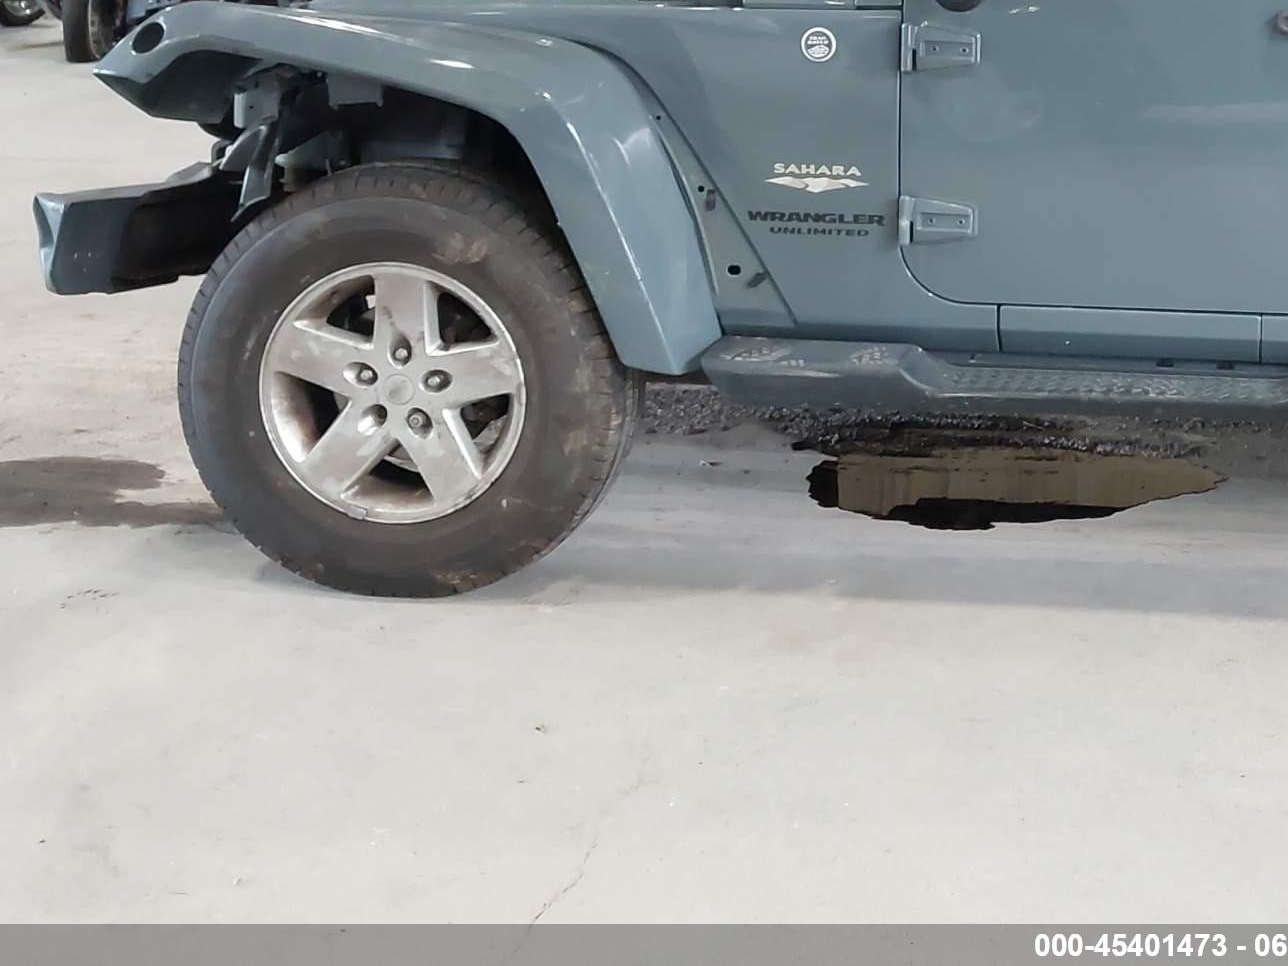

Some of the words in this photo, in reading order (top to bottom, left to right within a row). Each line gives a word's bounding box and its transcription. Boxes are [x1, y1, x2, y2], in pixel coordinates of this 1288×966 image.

[773, 163, 862, 176] SAHARA
[747, 210, 885, 226] WRANGLER
[769, 226, 869, 237] UNLIMITED
